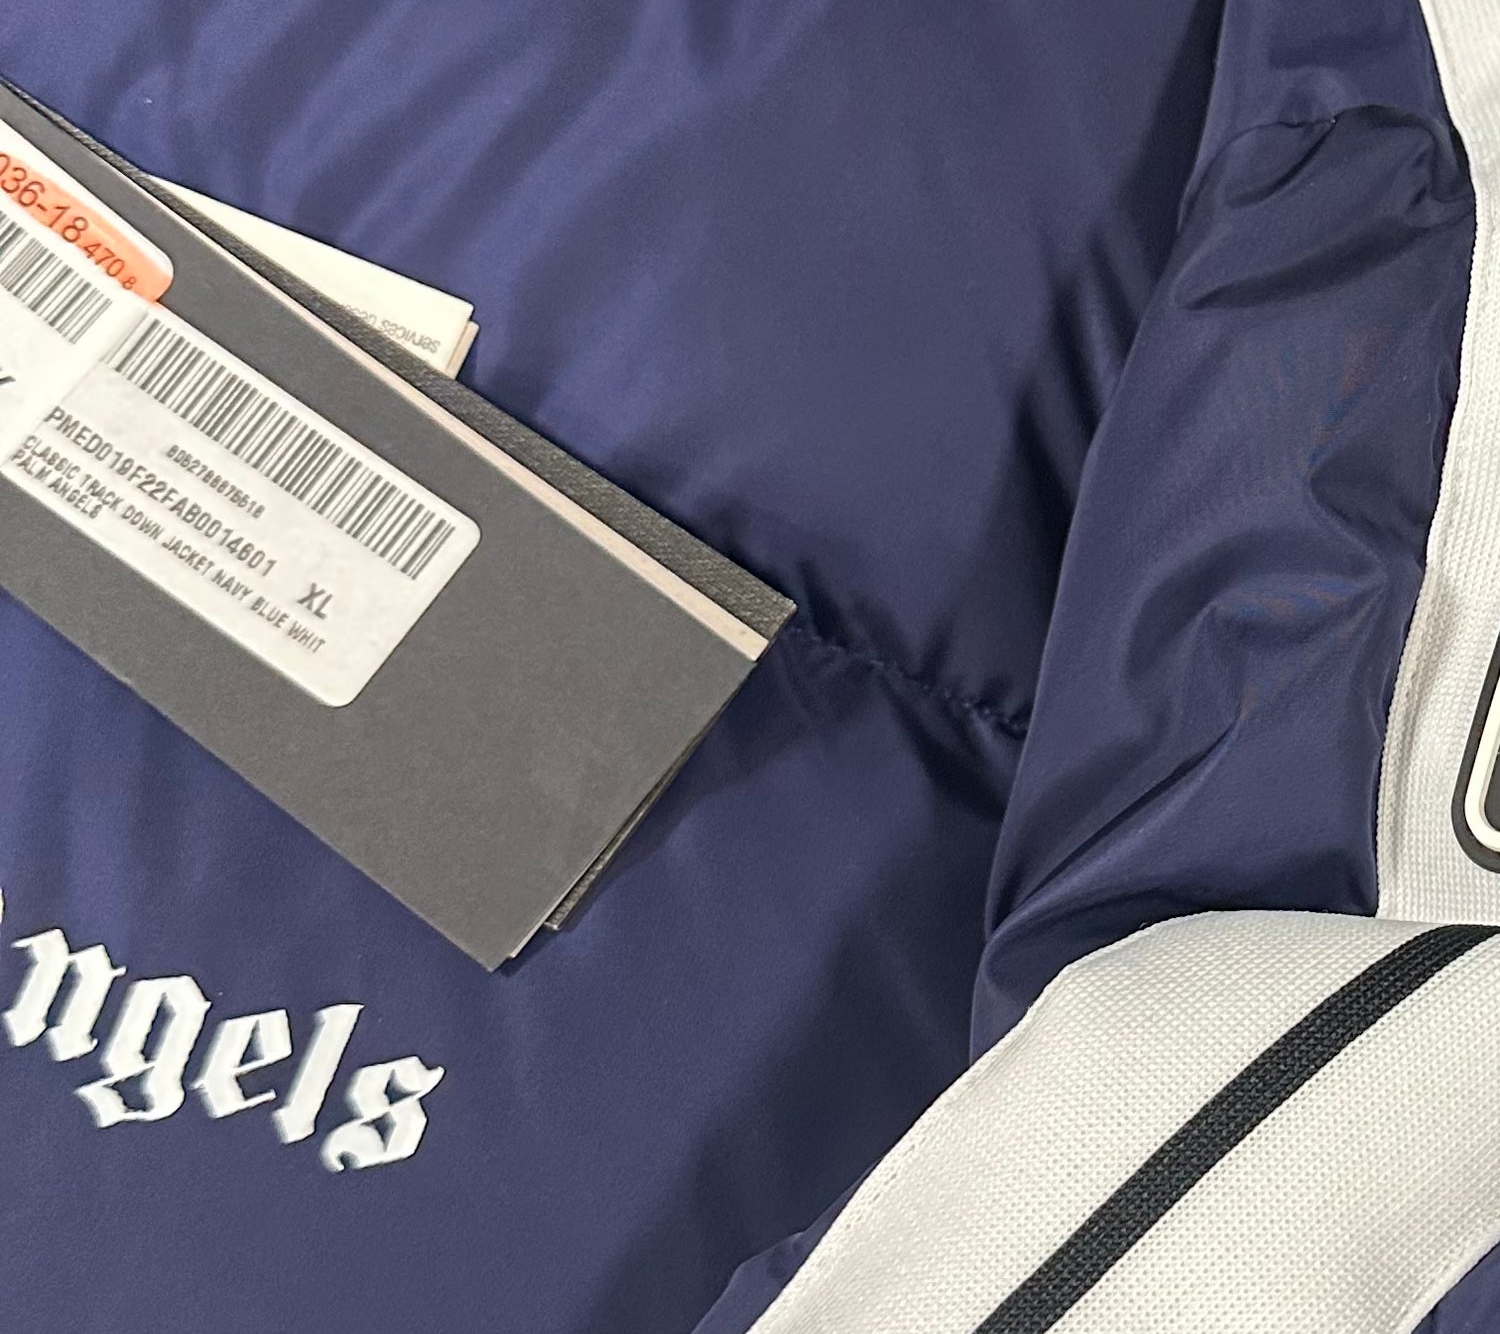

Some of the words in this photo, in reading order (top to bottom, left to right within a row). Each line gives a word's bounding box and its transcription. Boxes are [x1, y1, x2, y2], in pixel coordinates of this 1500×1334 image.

[380, 319, 442, 354] services
[10, 448, 52, 484] PALM
[48, 476, 104, 520] ANGELS
[23, 434, 81, 480] CLASSIC
[79, 473, 124, 512] TRACK
[121, 504, 164, 541] DOWN
[161, 535, 215, 577] JACKET
[211, 568, 254, 602] NAVY
[249, 596, 290, 629] BLUE
[287, 620, 327, 654] WHIT
[296, 582, 333, 620] XL
[0, 887, 446, 1173] ngels
